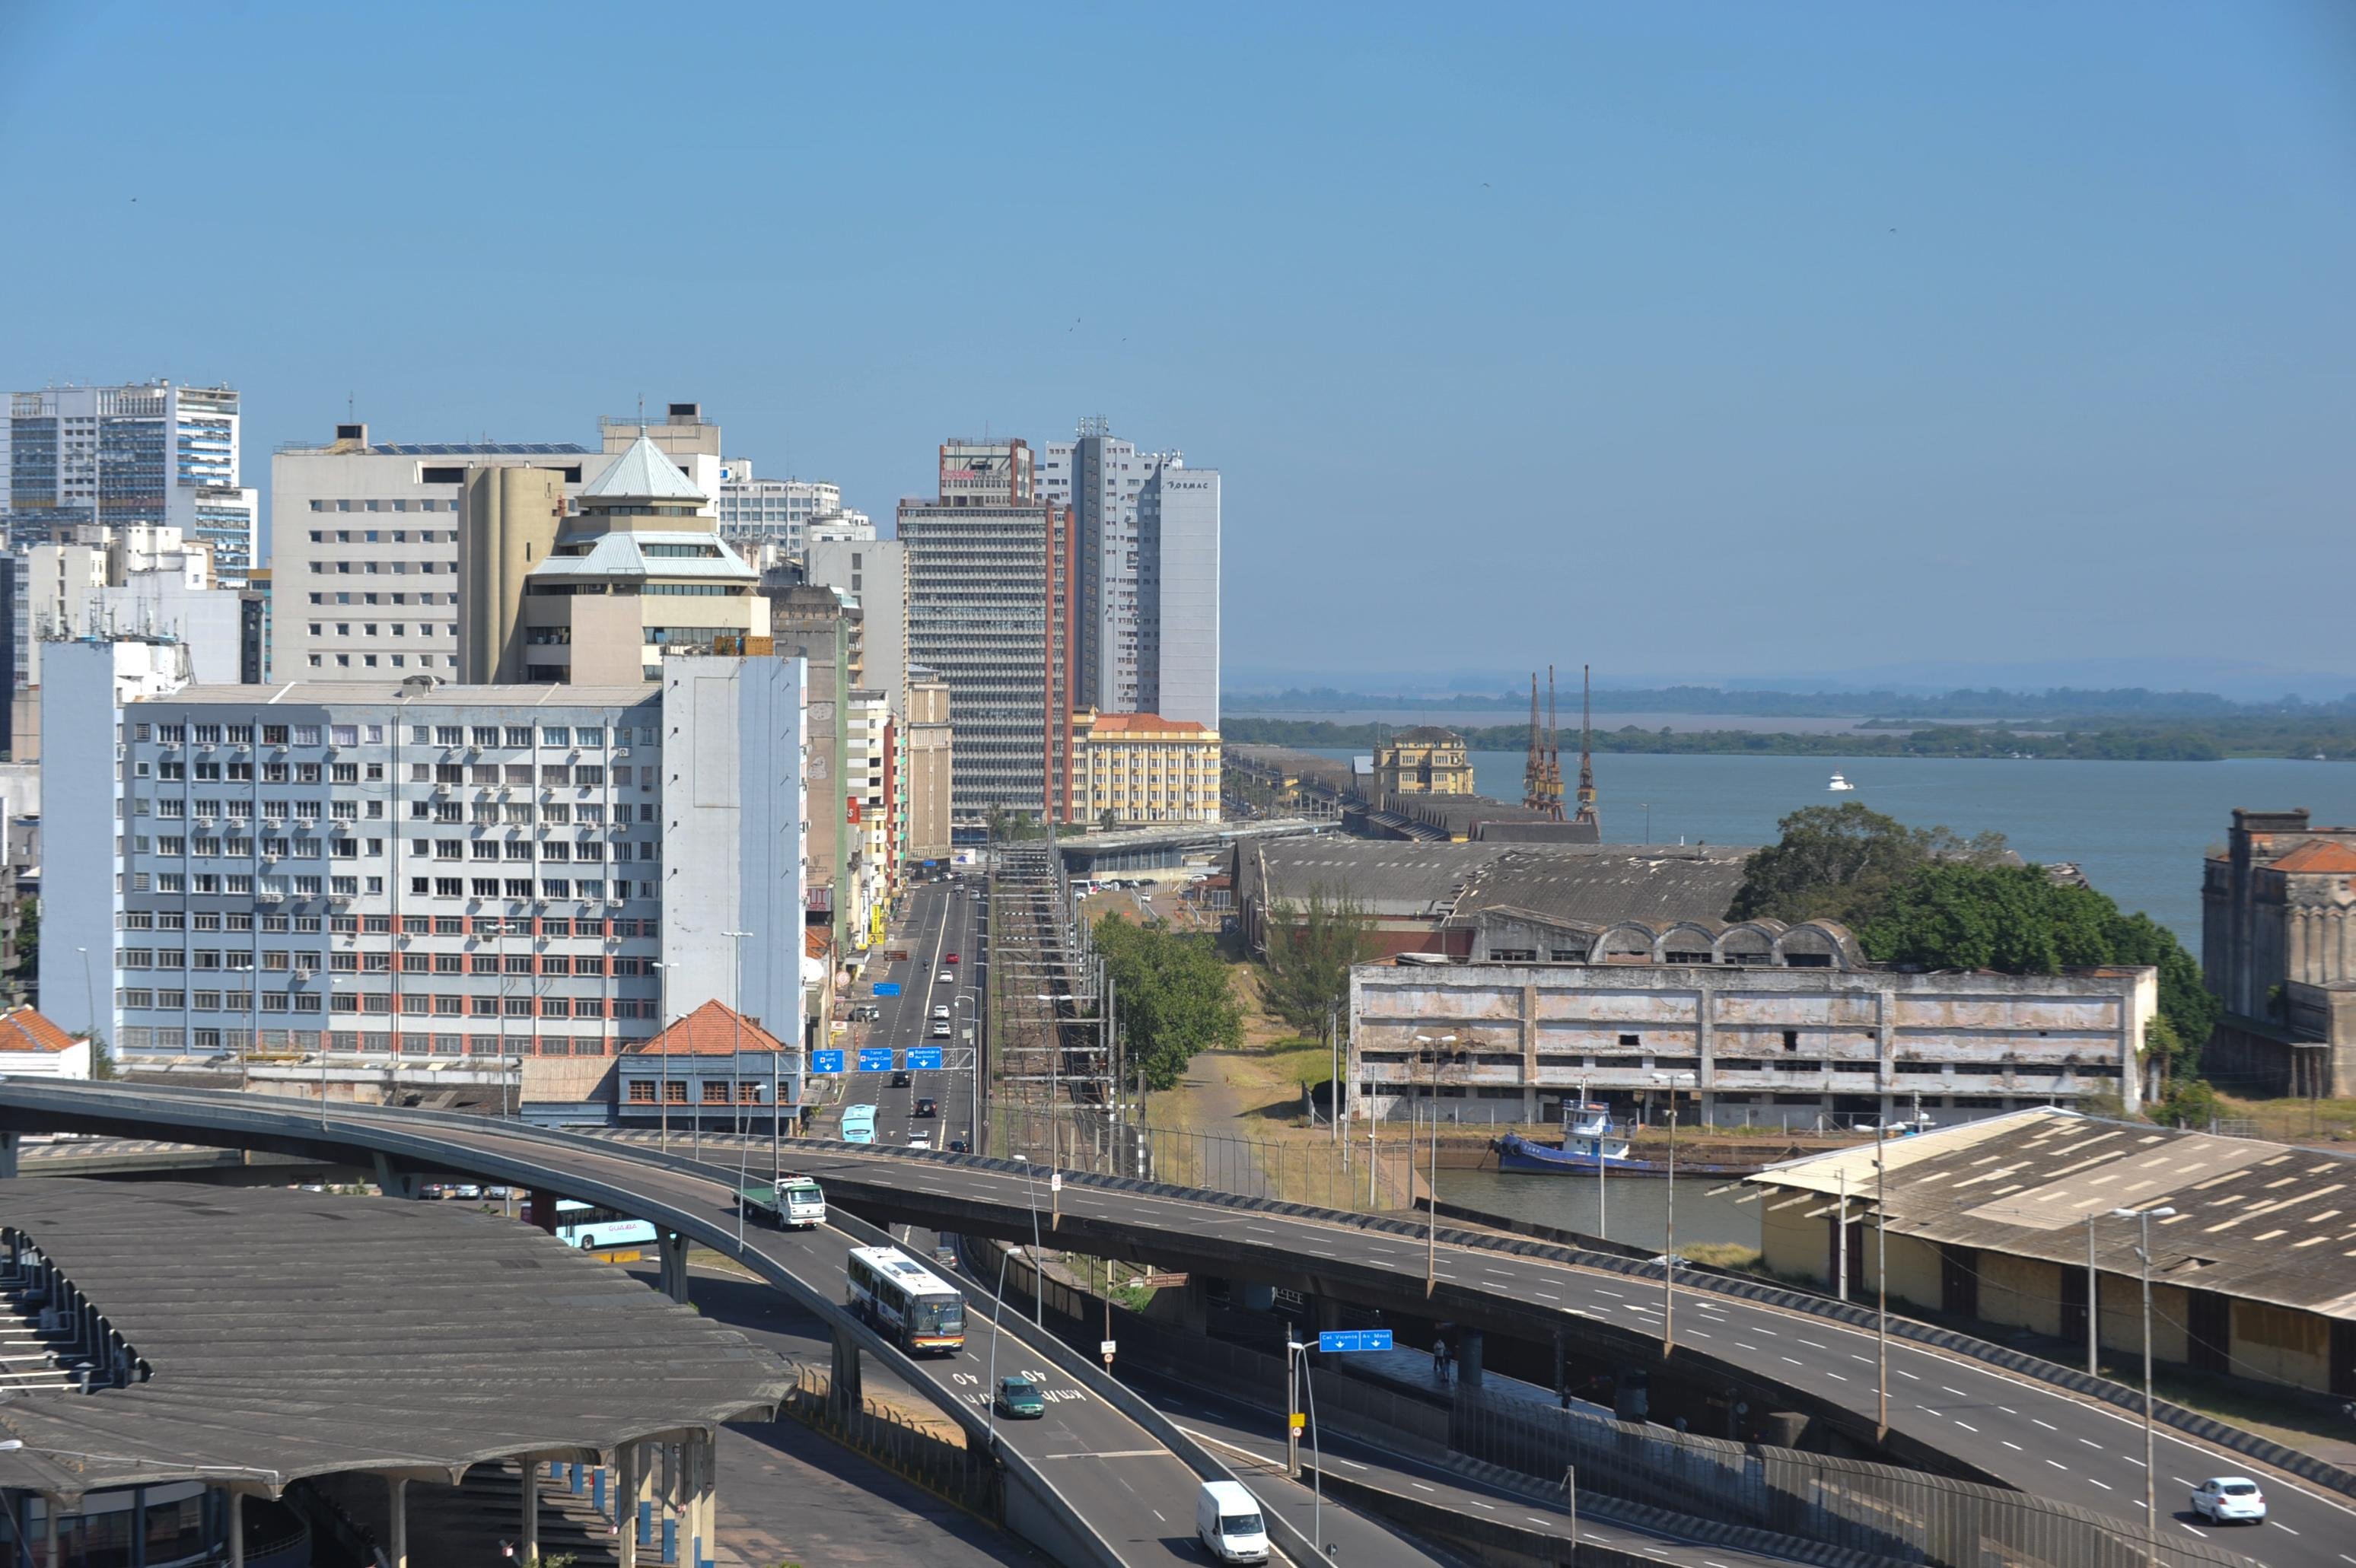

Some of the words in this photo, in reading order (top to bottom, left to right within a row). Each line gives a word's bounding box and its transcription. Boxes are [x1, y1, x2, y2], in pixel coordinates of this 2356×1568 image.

[952, 1372, 979, 1385] 40
[1020, 1369, 1047, 1382] 40
[1040, 1389, 1087, 1403] km/h
